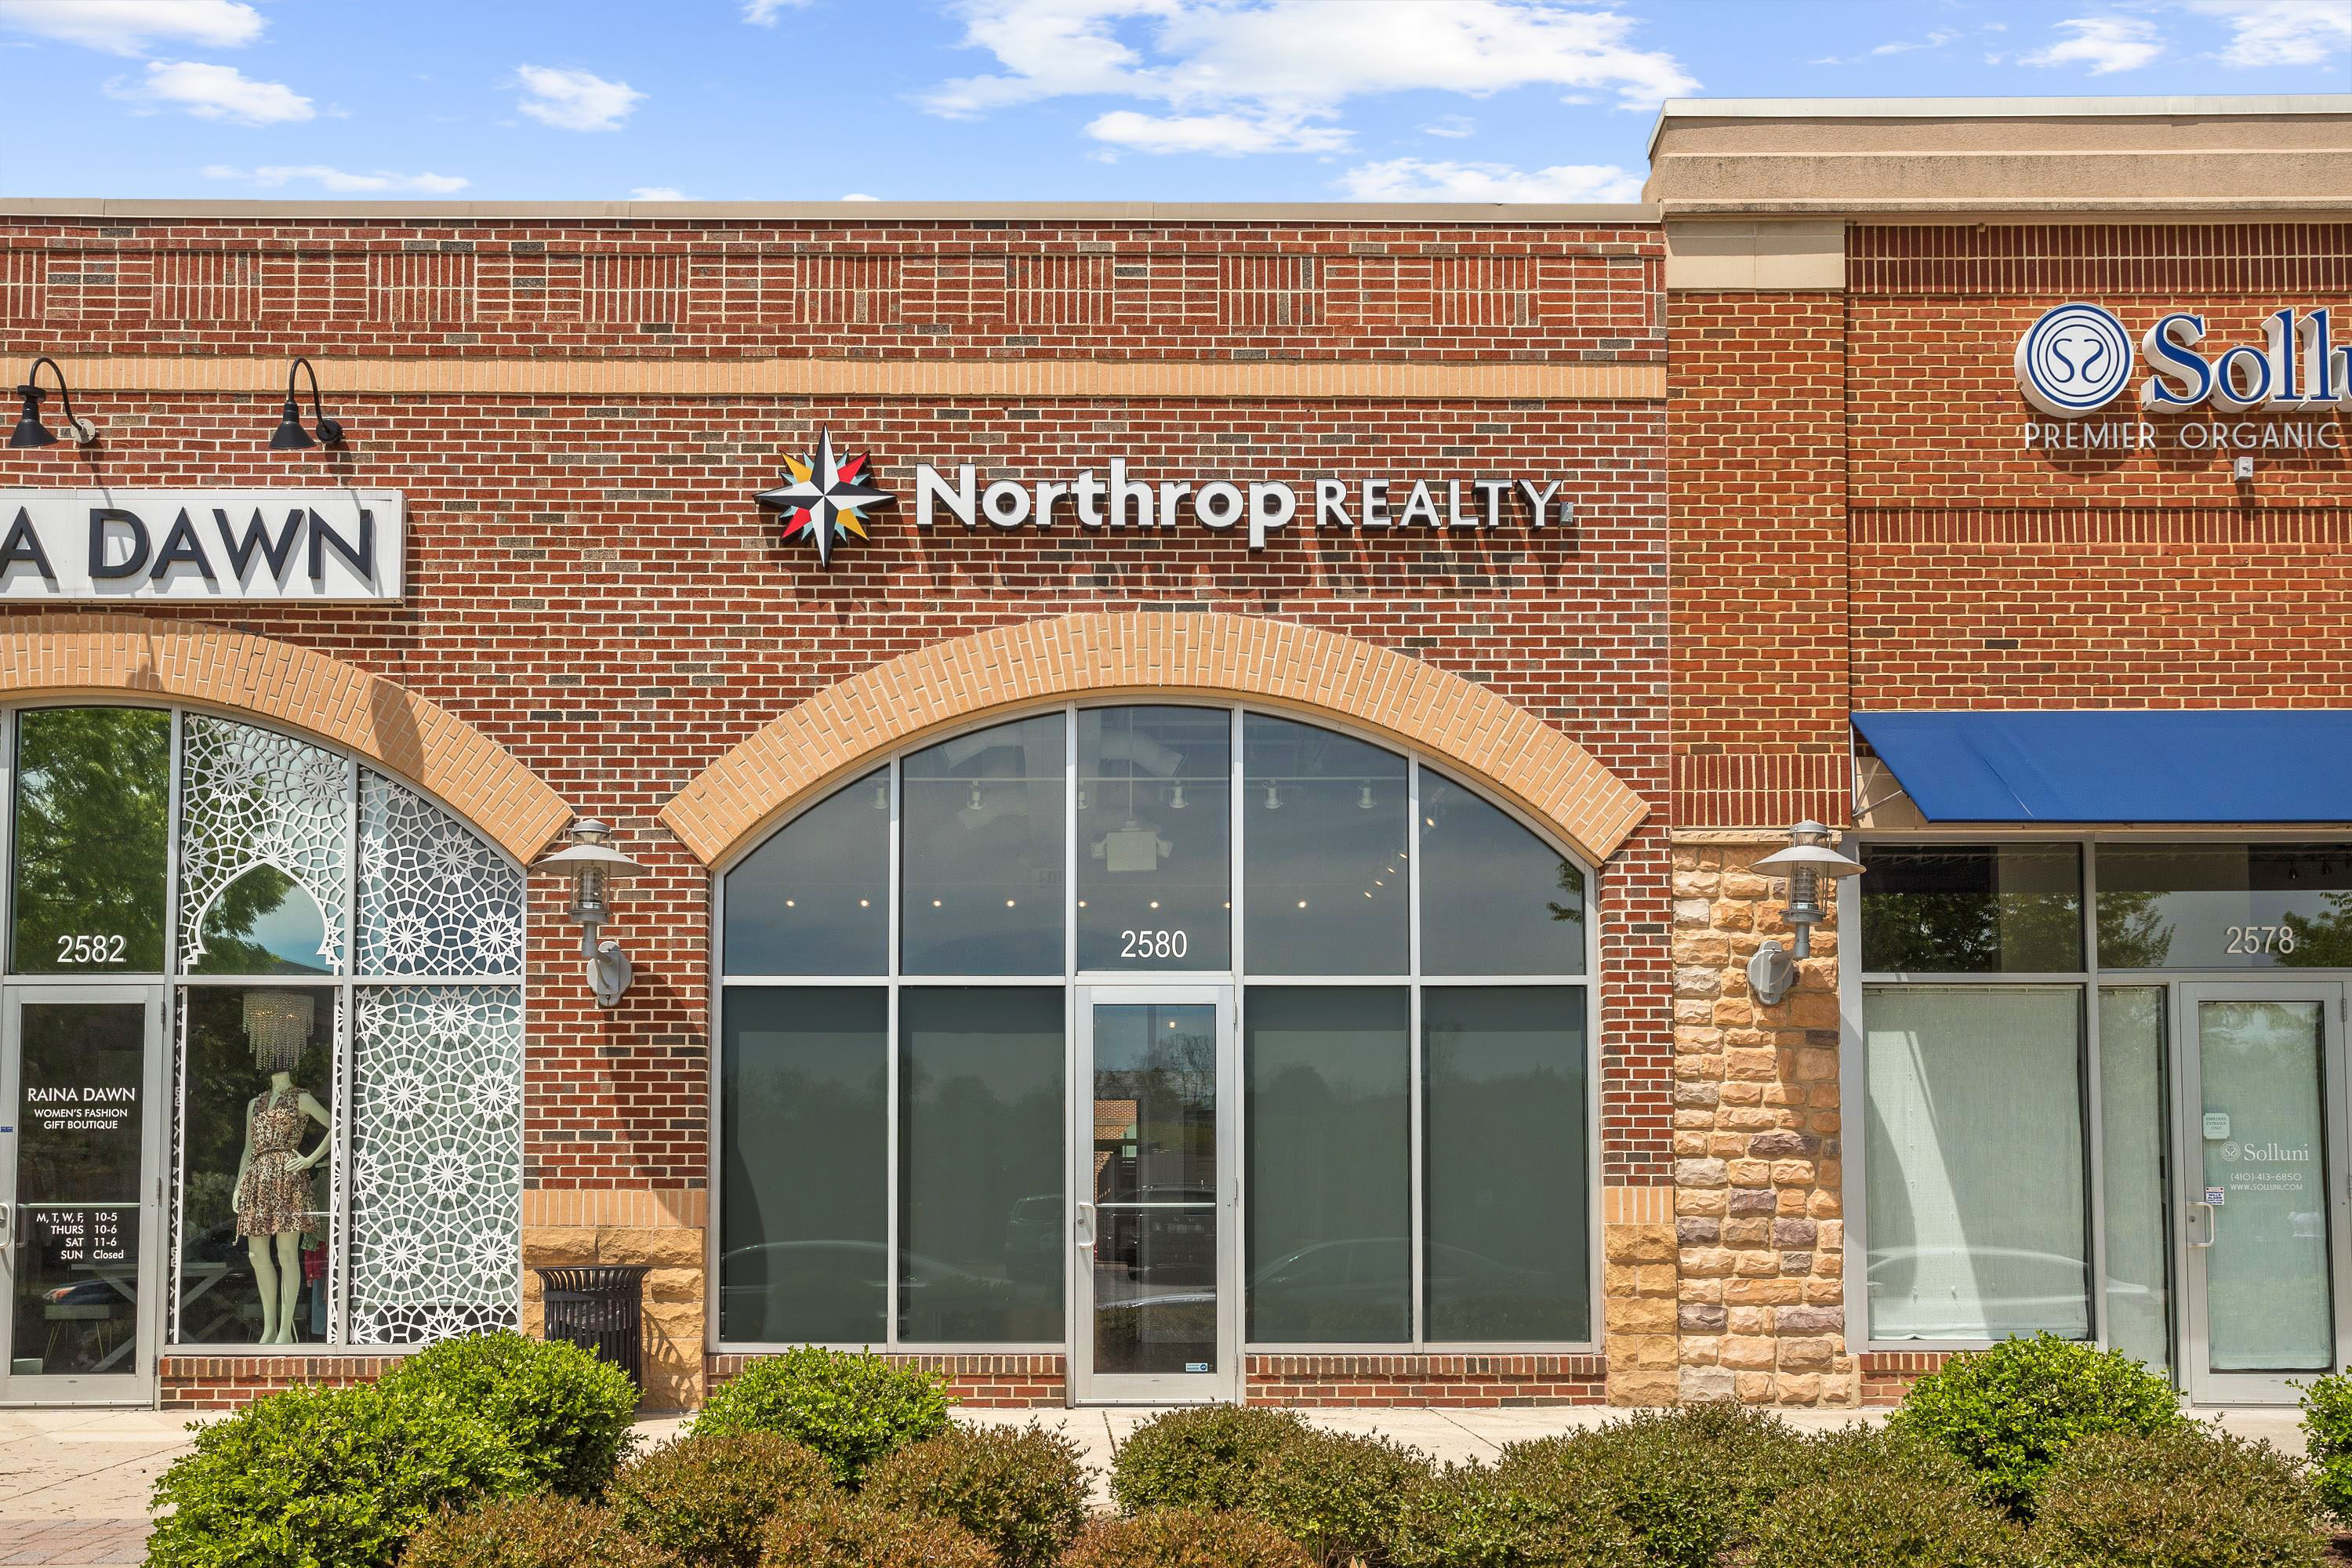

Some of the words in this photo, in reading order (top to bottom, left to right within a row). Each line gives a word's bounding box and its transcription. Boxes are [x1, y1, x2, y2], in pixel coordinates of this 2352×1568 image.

[2142, 307, 2352, 413] Soll
[2024, 422, 2156, 451] PREMIER
[2180, 422, 2341, 451] ORGANIC
[916, 457, 1297, 550] Northrop
[1315, 477, 1563, 530] REALTY
[89, 506, 376, 581] DAWN
[1120, 930, 1187, 958] 2580
[2226, 926, 2295, 954] 2578
[57, 935, 125, 963] 2582
[27, 1087, 78, 1102] RAINA
[83, 1087, 136, 1102] DAWN
[34, 1109, 82, 1118] WOMEN'S
[85, 1109, 128, 1118] FASHION
[43, 1120, 66, 1130] GIFT
[67, 1120, 118, 1130] BOUTIQUE
[2244, 1142, 2310, 1161] Solluni
[2230, 1172, 2255, 1181] (410)
[2257, 1172, 2302, 1181] 413-6850
[36, 1212, 49, 1223] M,
[51, 1212, 60, 1223] T,
[62, 1212, 74, 1223] W,
[77, 1212, 84, 1223] F,
[95, 1212, 118, 1221] 10-5
[50, 1225, 84, 1235] THURS
[94, 1225, 118, 1234] 10-6
[65, 1237, 84, 1247] SAT
[94, 1237, 117, 1247] 11-6
[60, 1250, 83, 1260] SUN
[93, 1249, 124, 1260] Closed
